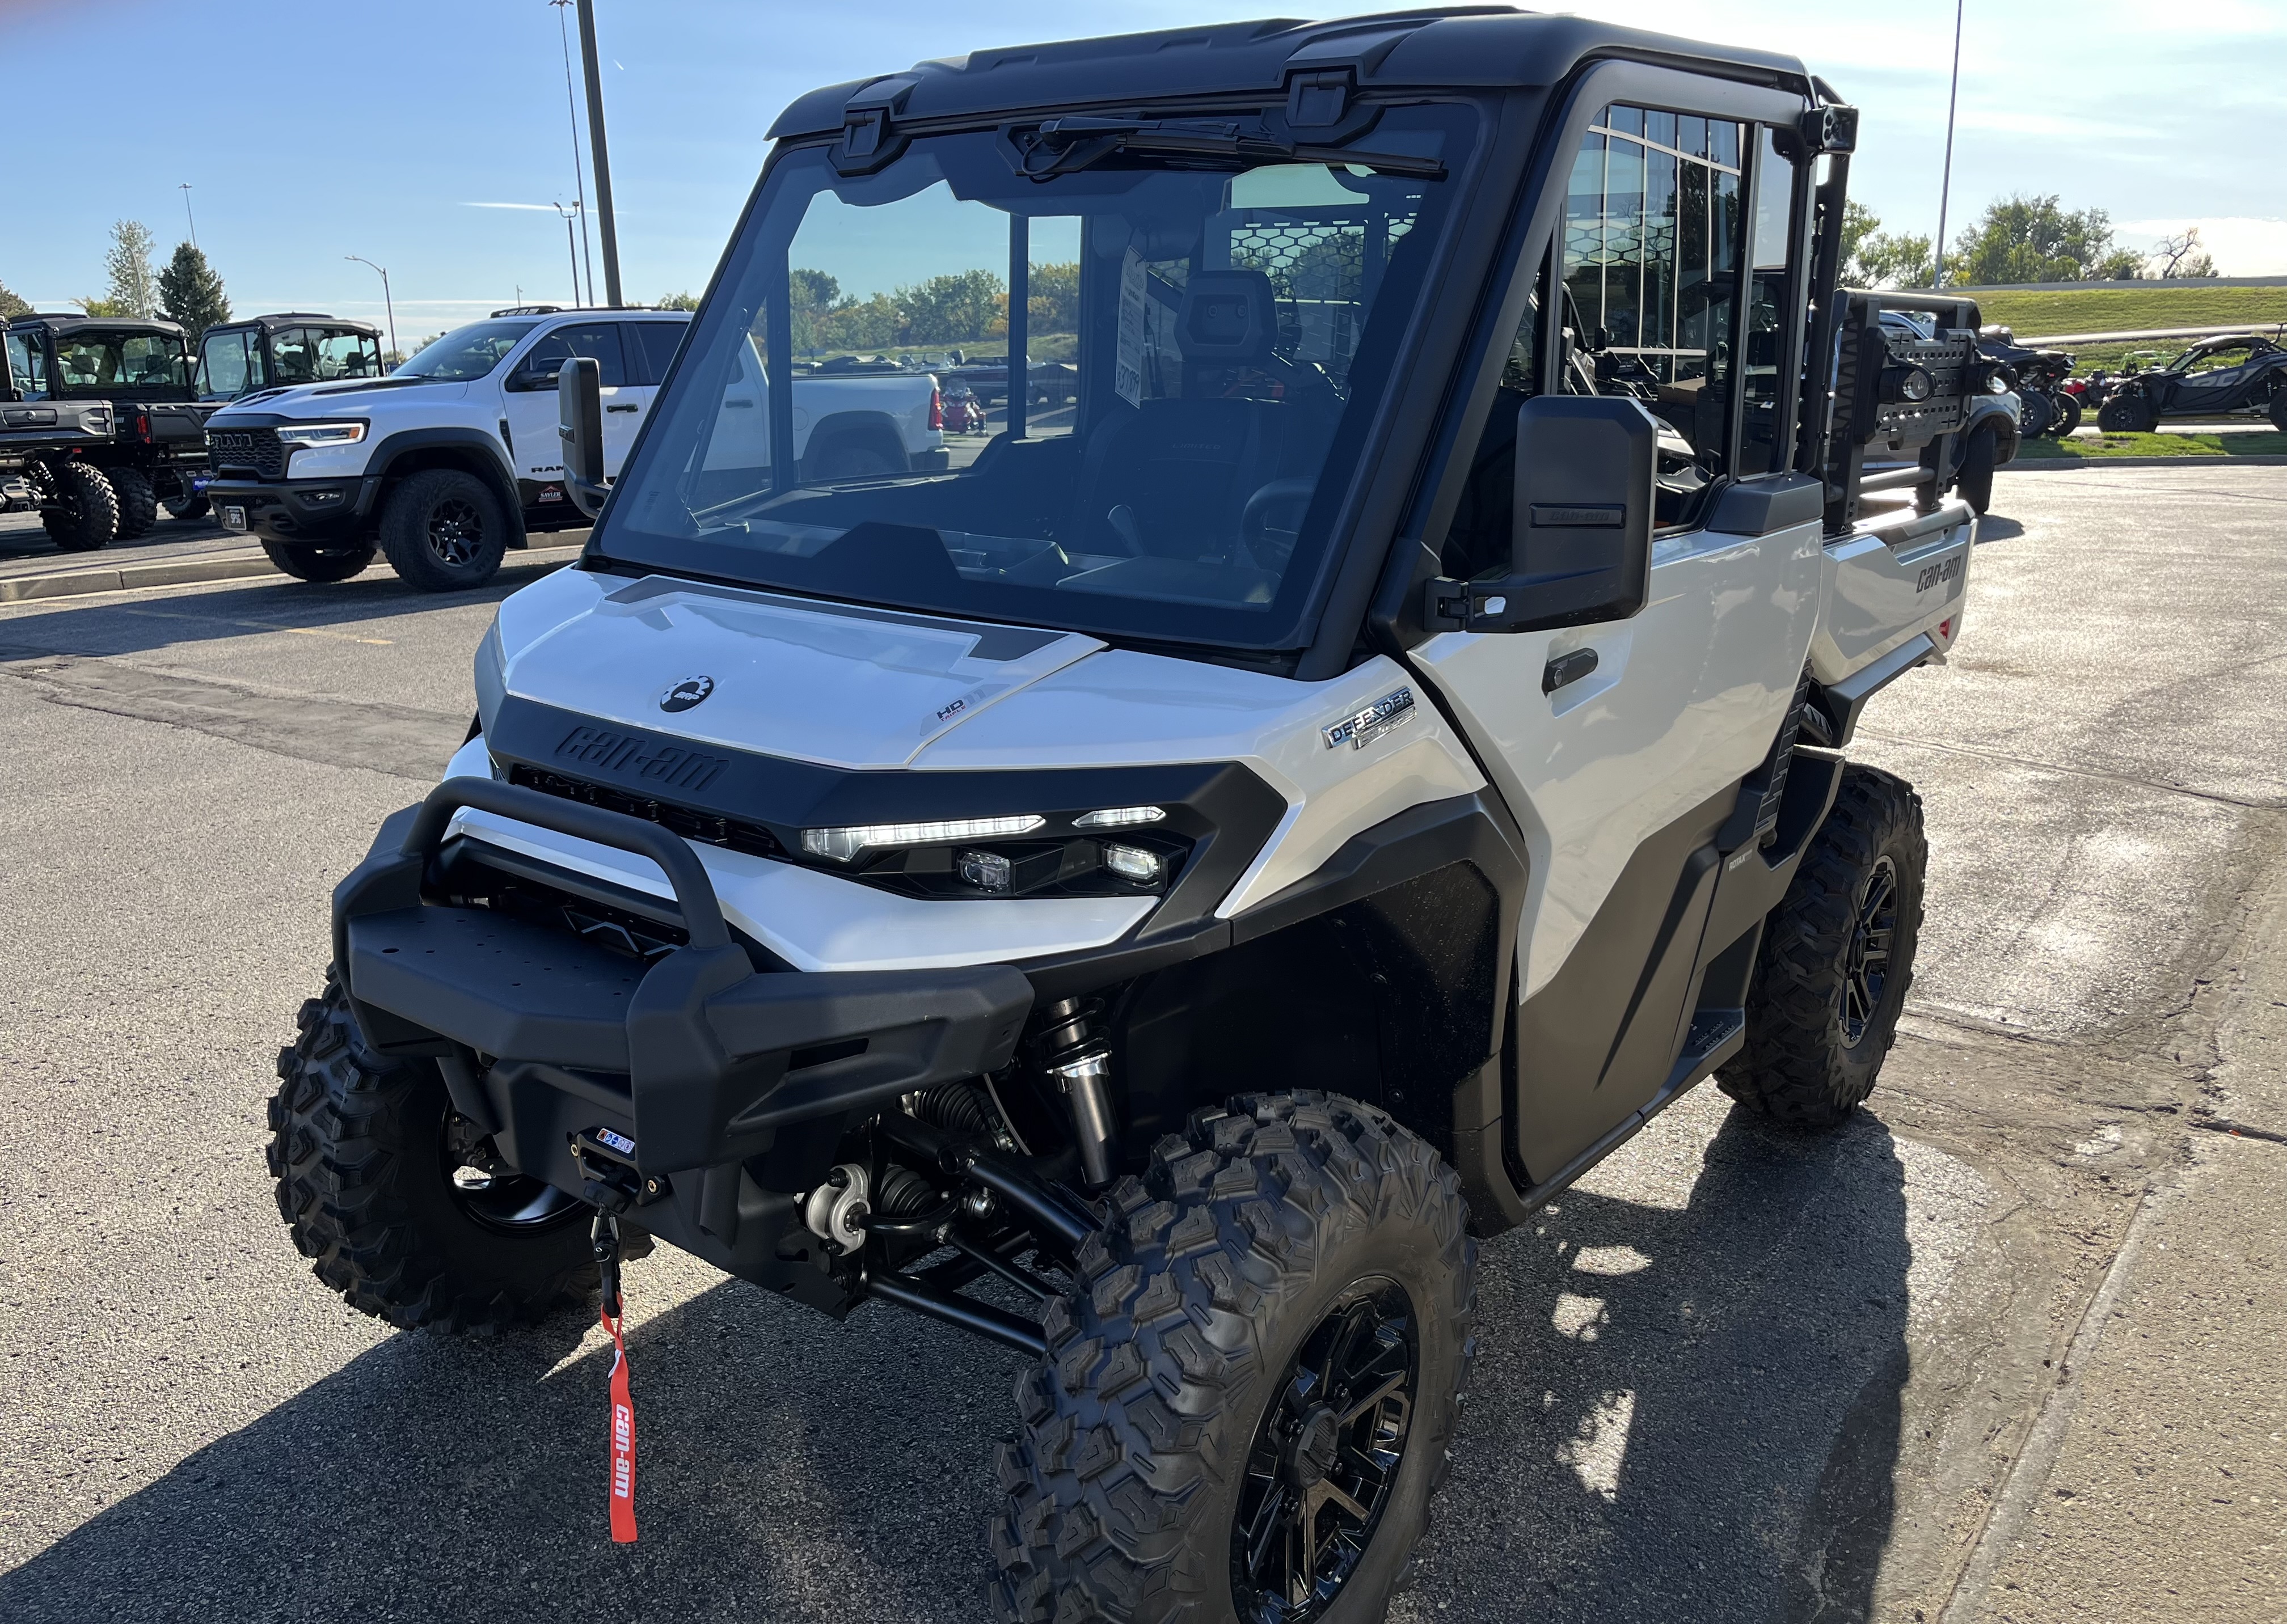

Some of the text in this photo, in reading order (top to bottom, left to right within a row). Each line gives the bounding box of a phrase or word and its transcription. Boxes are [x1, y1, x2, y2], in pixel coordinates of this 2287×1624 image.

[210, 434, 253, 449] RAM
[1916, 555, 1961, 594] can-am
[673, 691, 700, 701] BRP
[1330, 690, 1411, 743] DEFENDER
[554, 725, 731, 792] can-am
[1728, 854, 1745, 872] ROTAX
[614, 1403, 630, 1498] can-am
